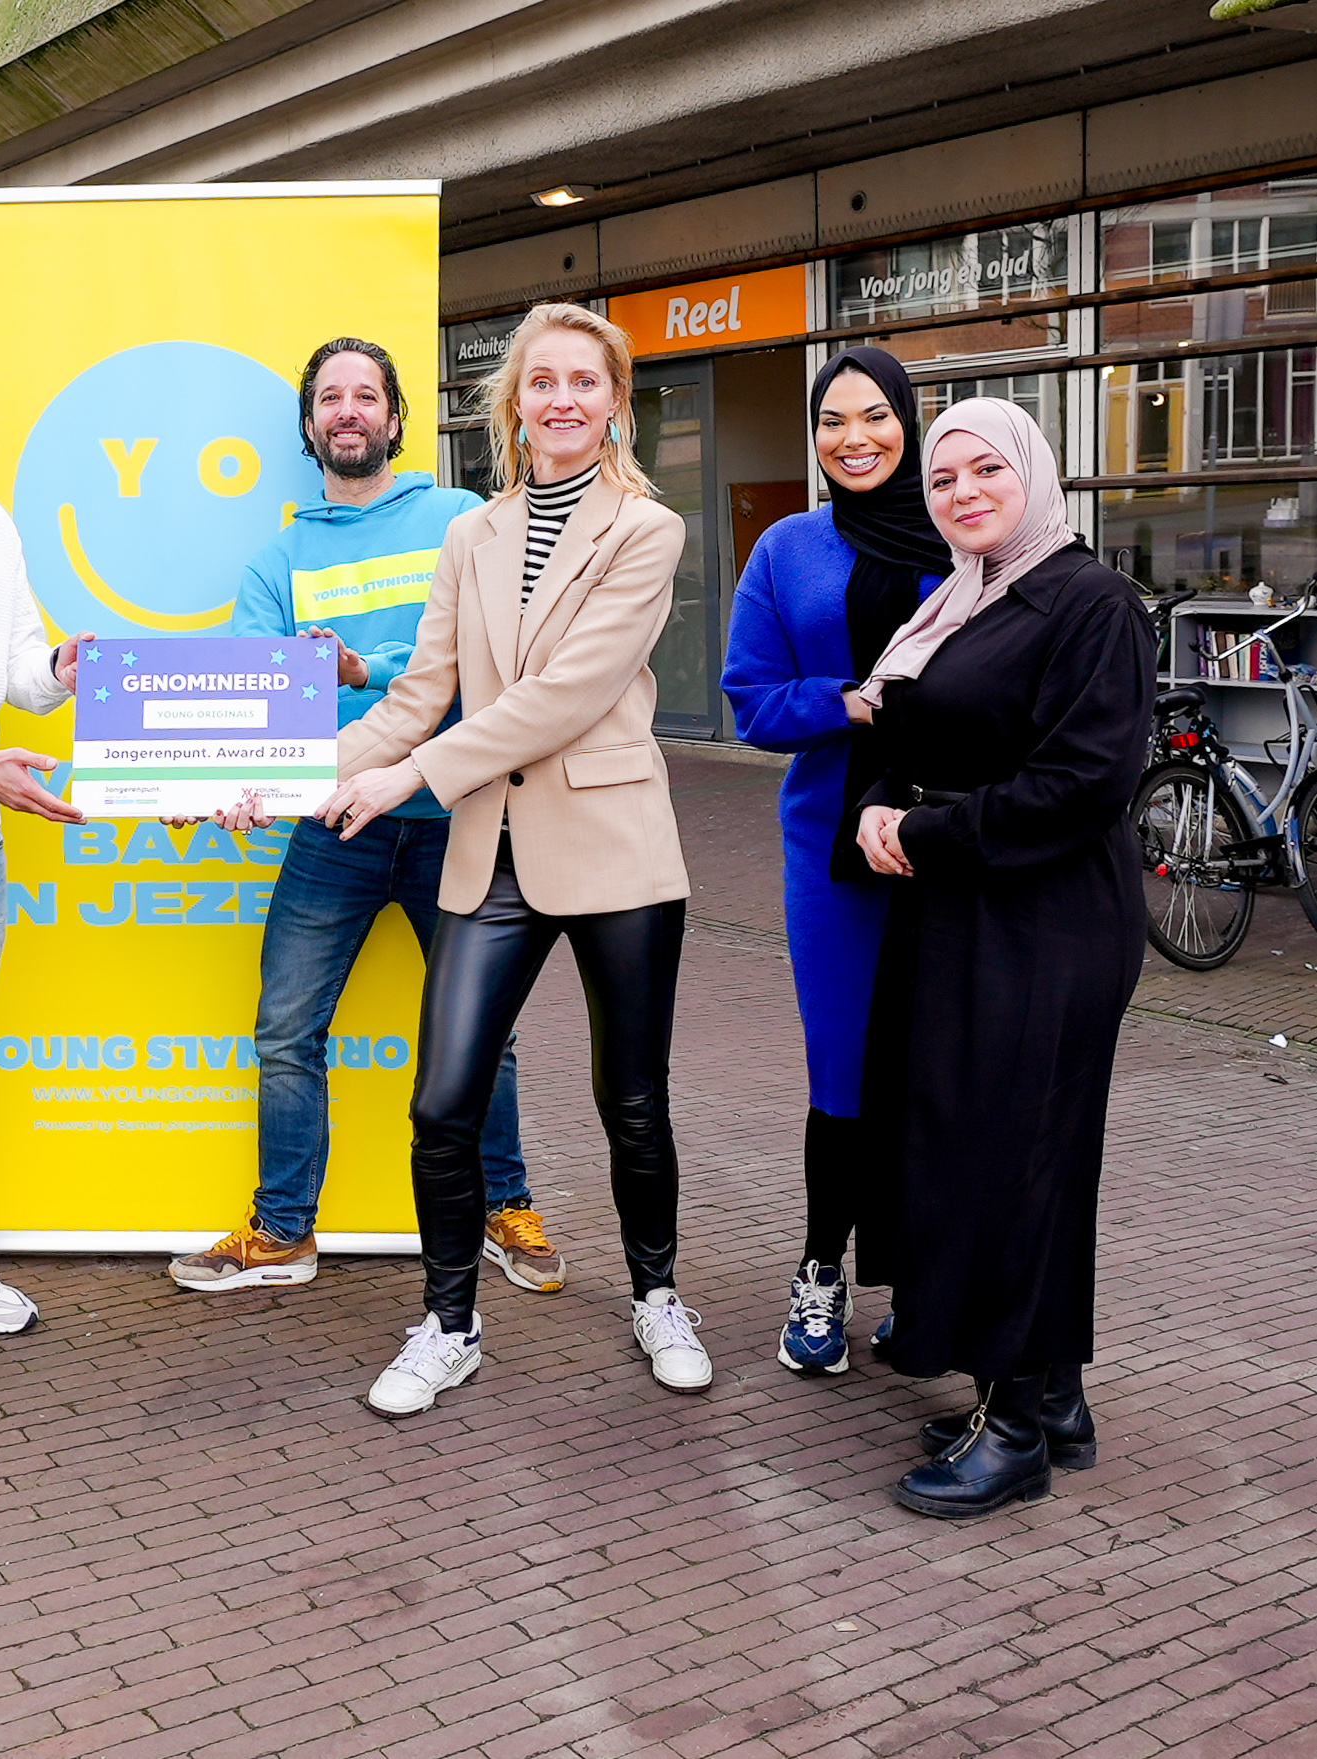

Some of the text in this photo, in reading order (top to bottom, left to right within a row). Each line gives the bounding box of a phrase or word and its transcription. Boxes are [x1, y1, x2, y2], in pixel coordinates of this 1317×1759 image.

[860, 249, 1030, 299] Voor jong en oud
[665, 285, 742, 340] Reel
[458, 332, 513, 360] Activitei
[313, 572, 434, 602] YOUNG ORIGINALS
[122, 673, 290, 692] GENOMINEERD
[157, 709, 255, 719] YOUNG ORIGINALS
[104, 747, 306, 761] Jongerenpunt. Award 2023
[63, 820, 296, 865] BAAS
[6, 881, 276, 926] N JEZE
[146, 1034, 411, 1070] ORINALS
[32, 1086, 339, 1102] WWW.YOUNGORIGIN
[96, 1120, 113, 1133] by
